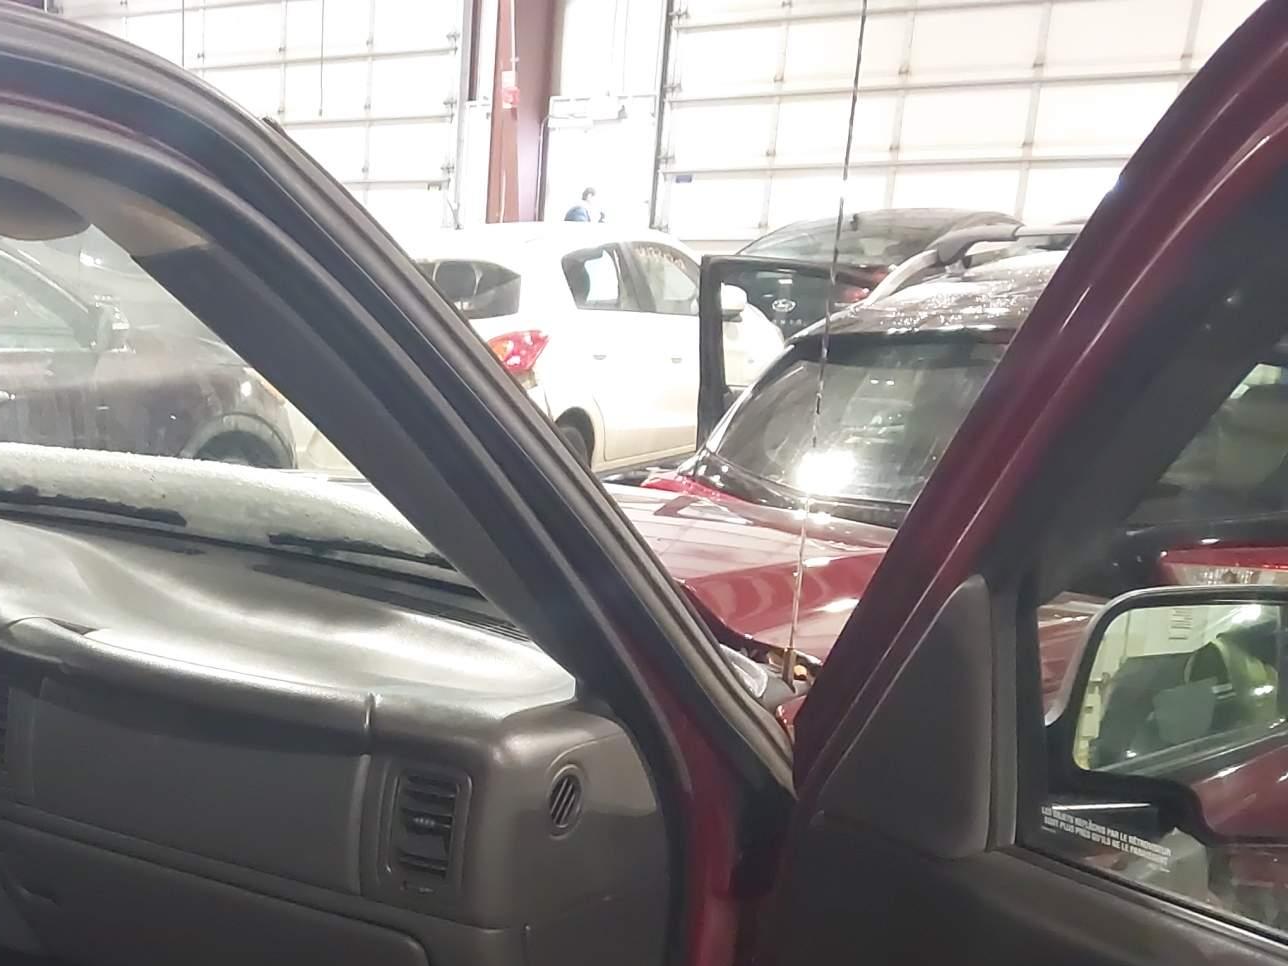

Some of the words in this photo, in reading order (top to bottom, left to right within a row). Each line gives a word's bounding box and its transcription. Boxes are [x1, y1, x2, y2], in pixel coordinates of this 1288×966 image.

[1059, 821, 1075, 833] PLUS
[1111, 839, 1121, 849] NE
[1121, 842, 1129, 852] LE
[1106, 828, 1120, 840] PAR
[1120, 832, 1128, 843] LE
